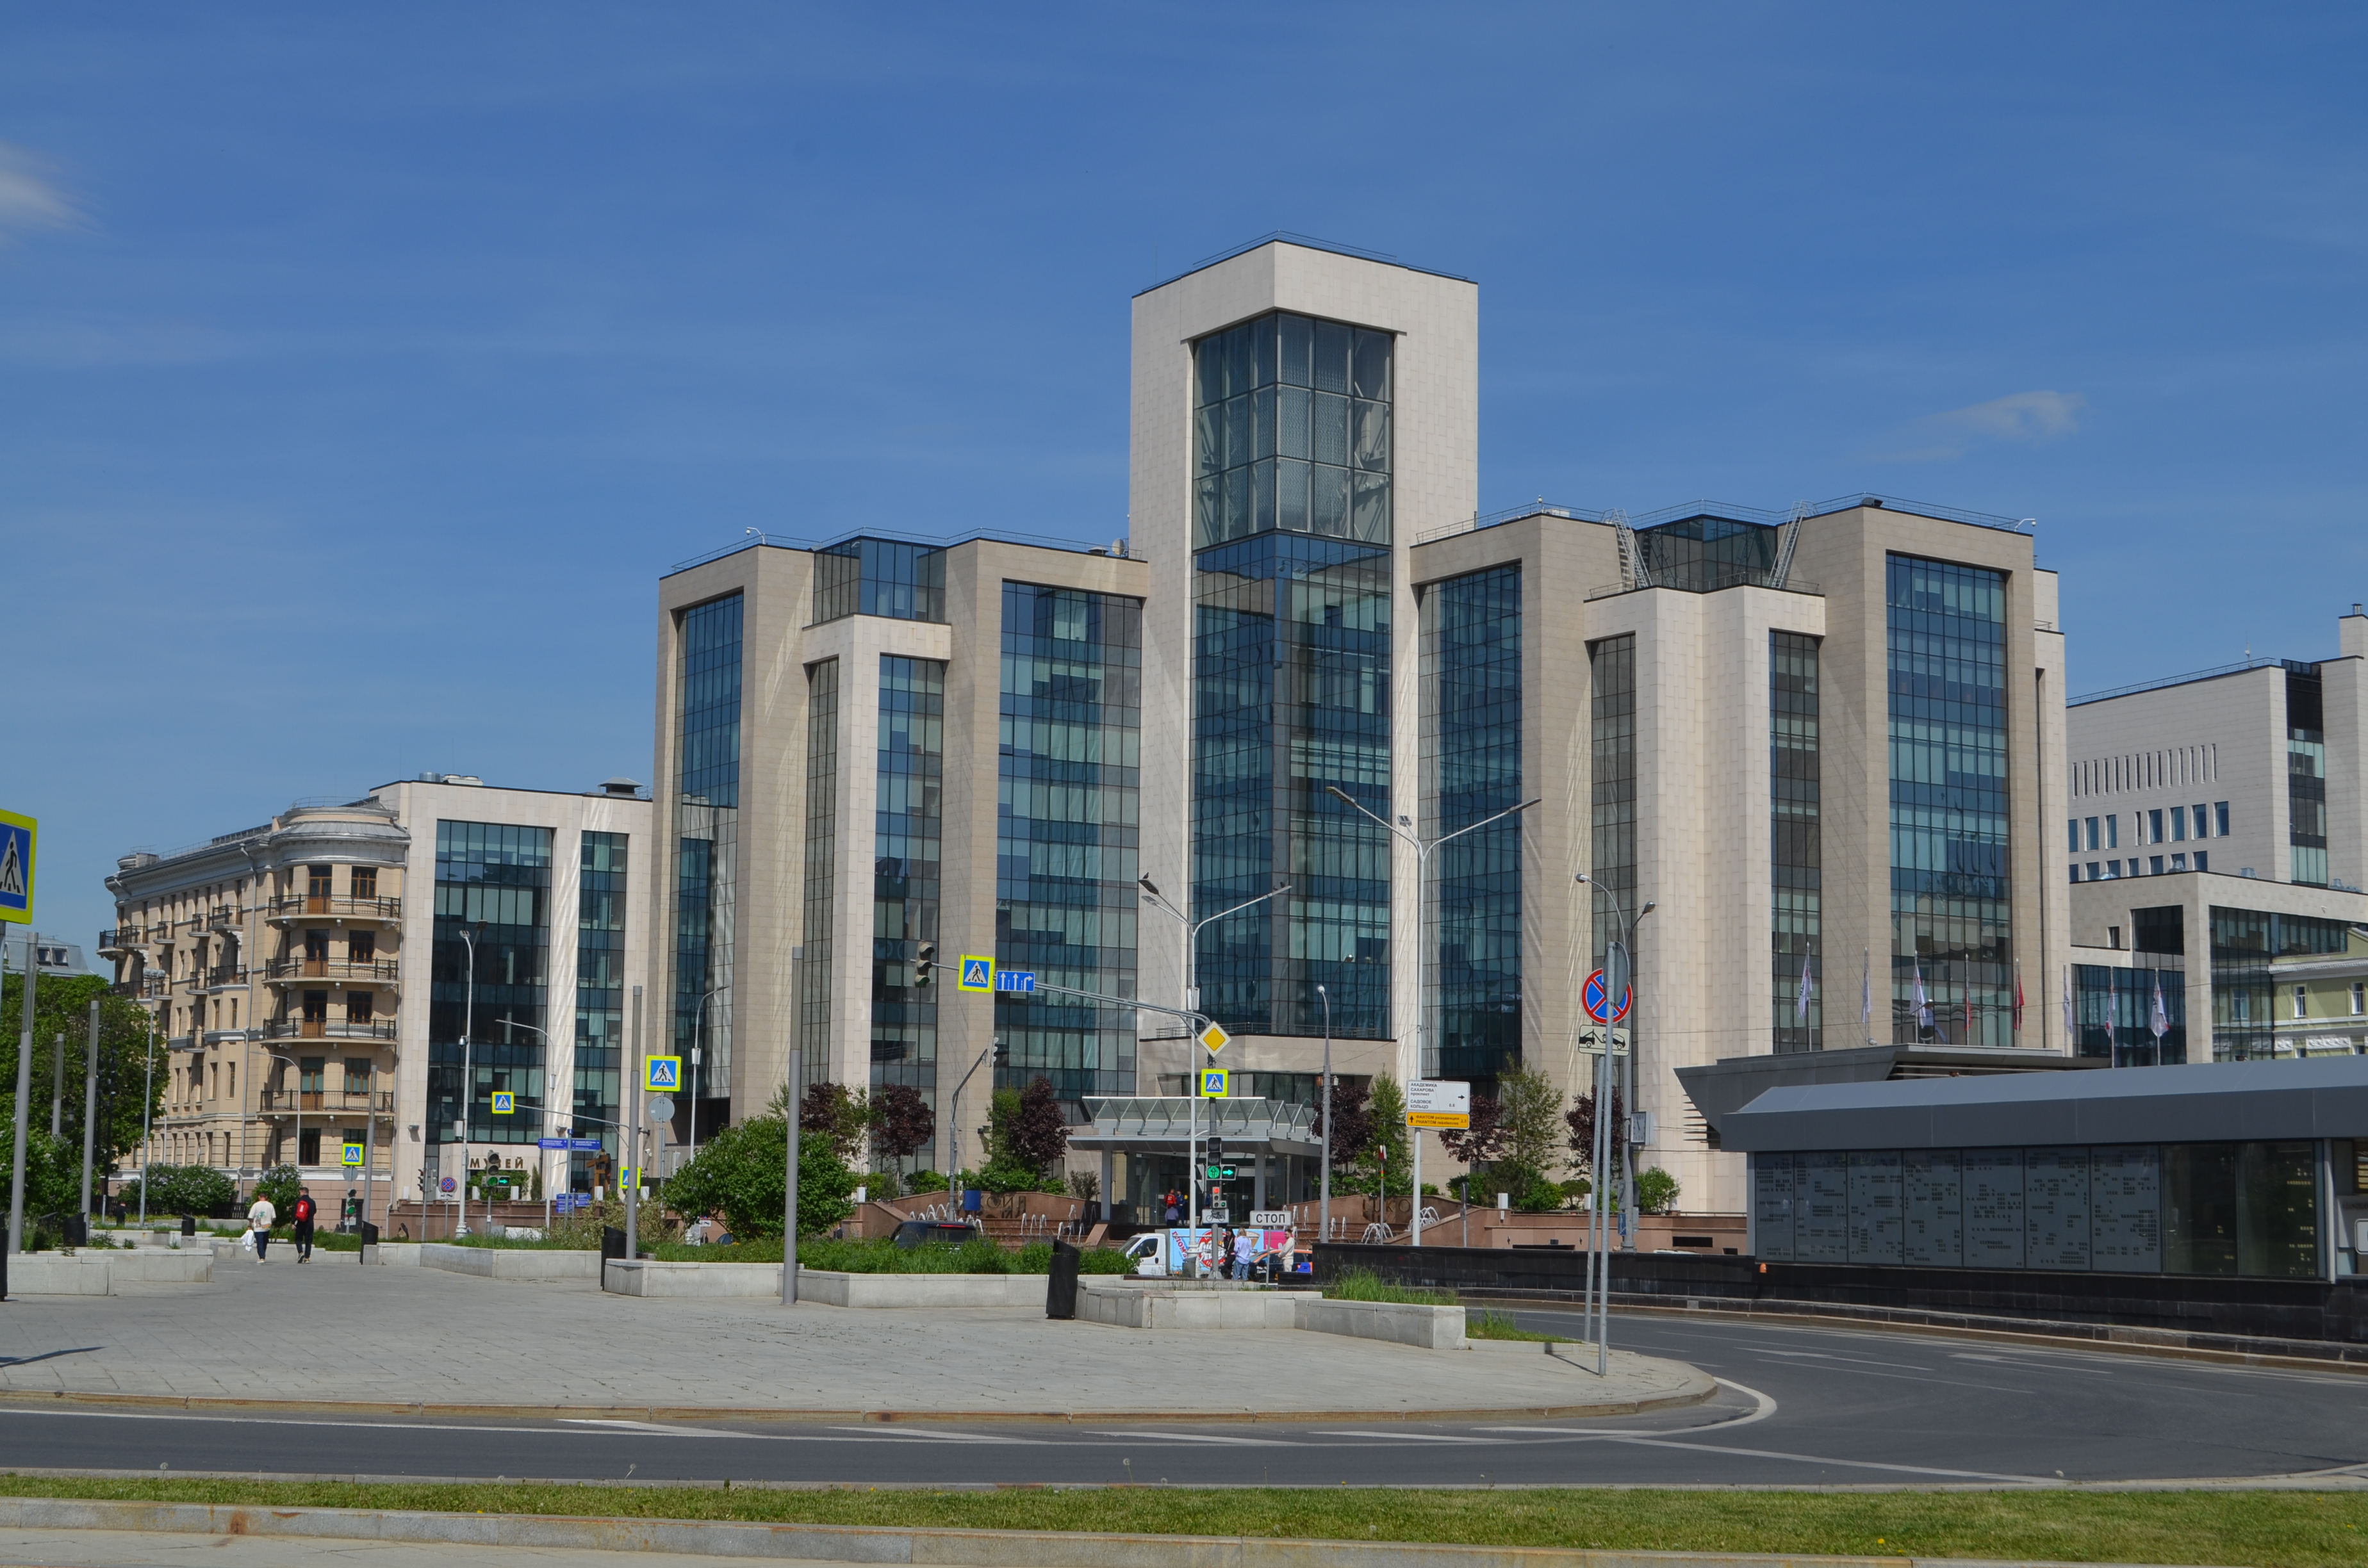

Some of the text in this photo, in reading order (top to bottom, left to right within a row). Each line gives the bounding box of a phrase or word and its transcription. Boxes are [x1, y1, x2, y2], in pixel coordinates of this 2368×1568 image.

[470, 1156, 523, 1169] МЕЙ
[1362, 1198, 1425, 1213] LUKO
[1256, 1214, 1285, 1223] СТОП
